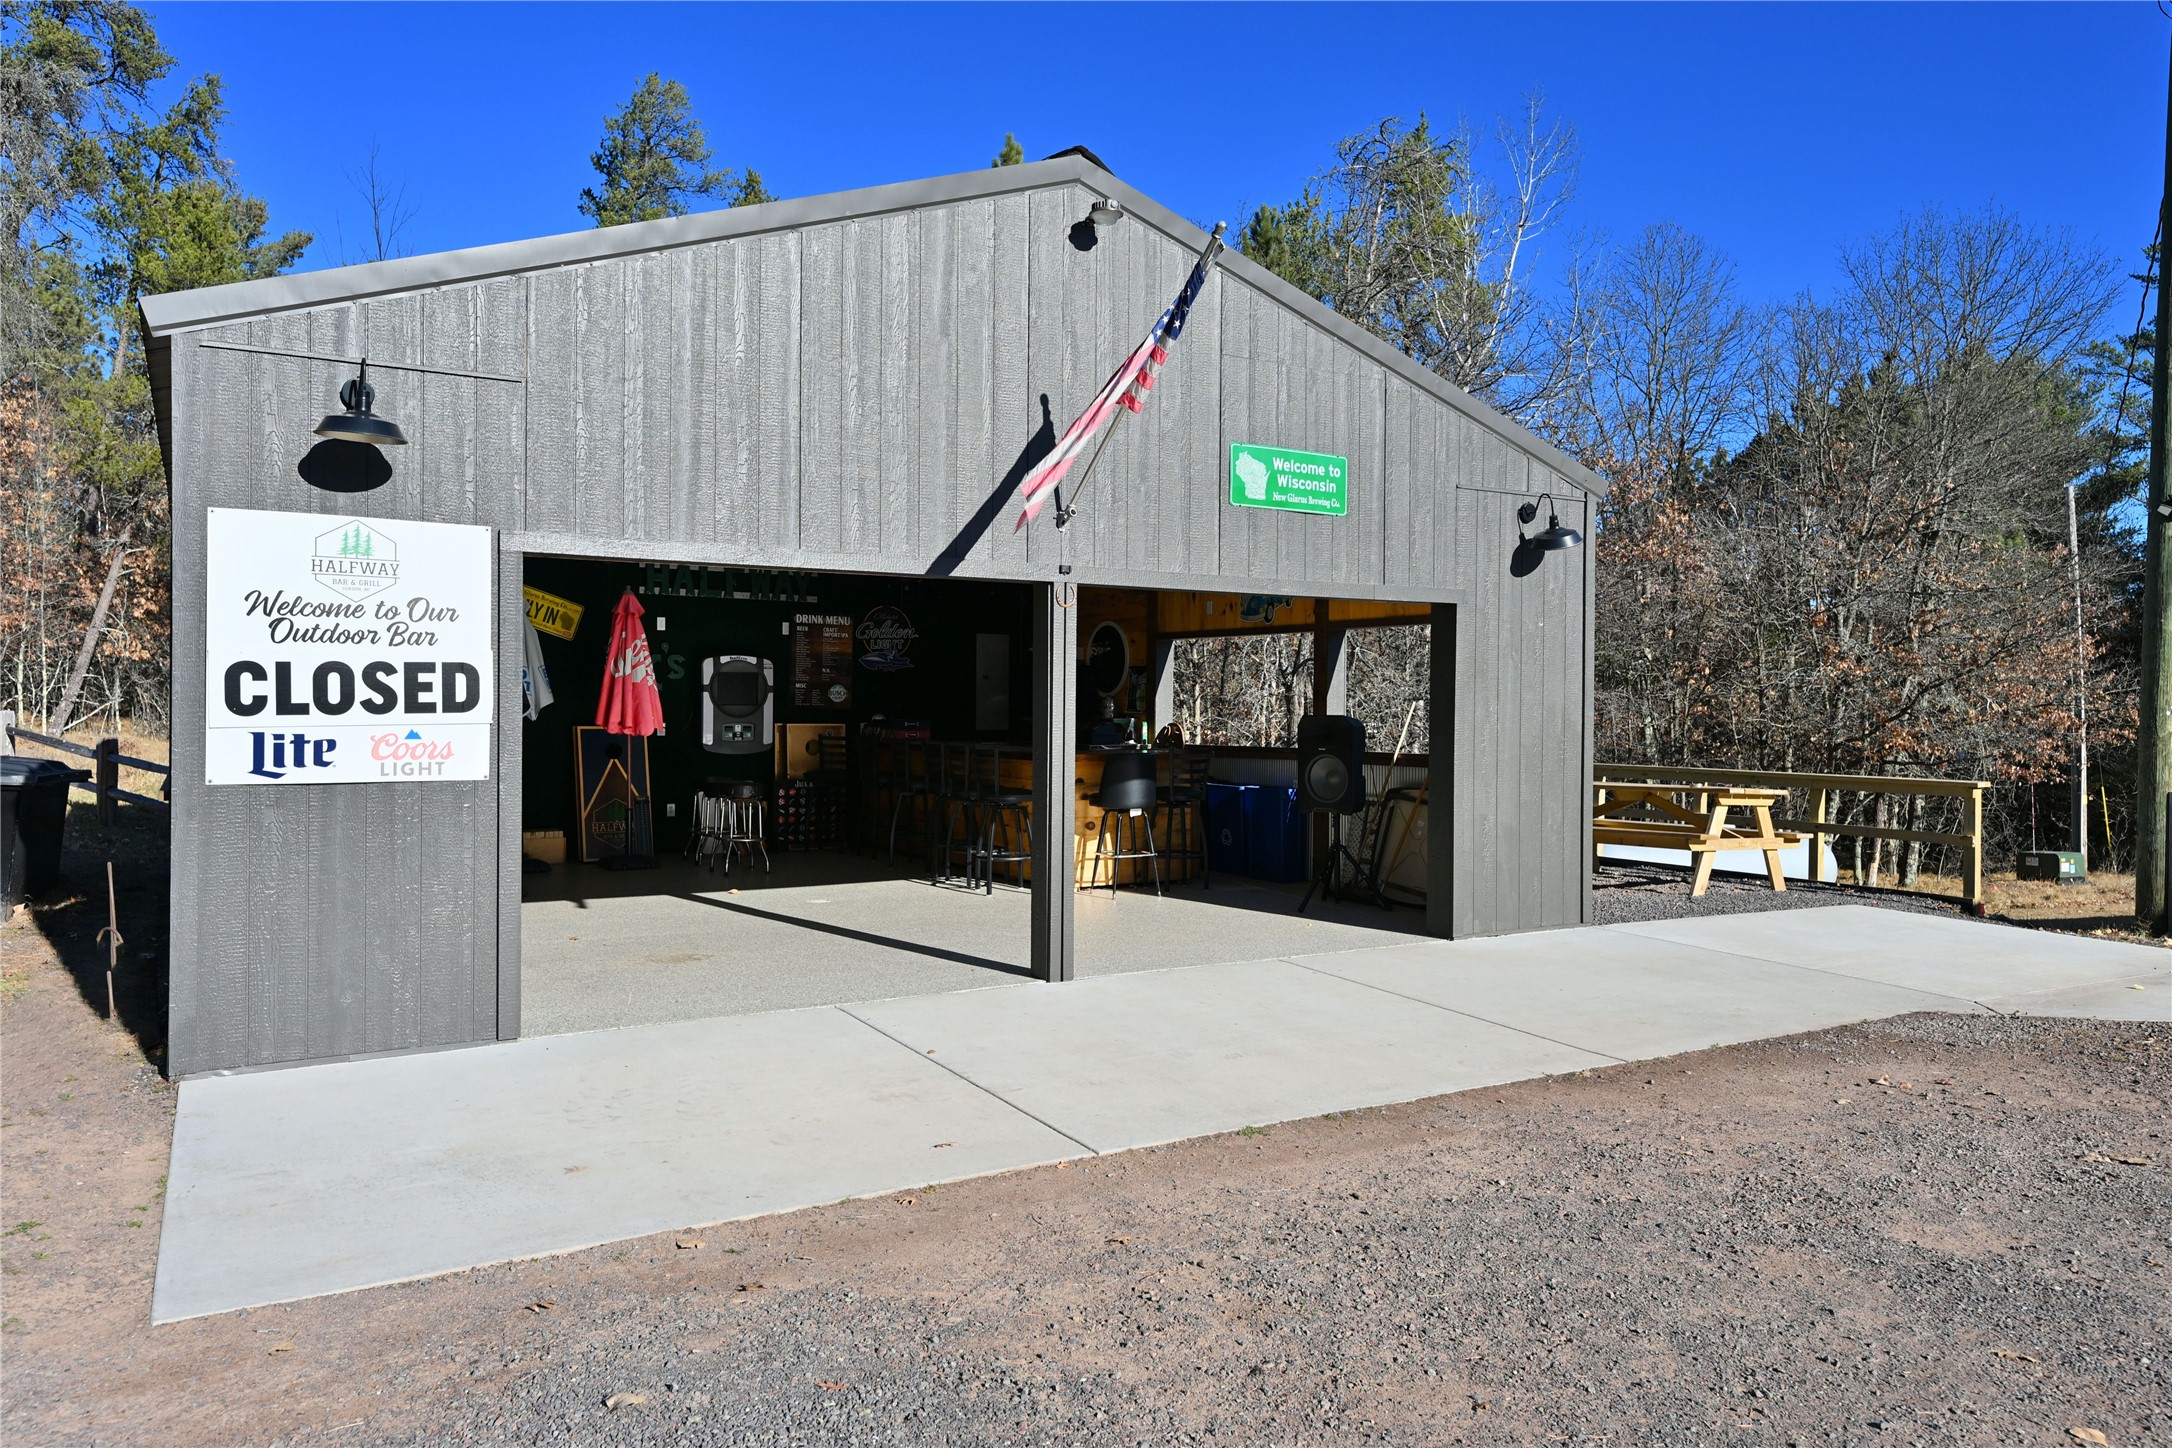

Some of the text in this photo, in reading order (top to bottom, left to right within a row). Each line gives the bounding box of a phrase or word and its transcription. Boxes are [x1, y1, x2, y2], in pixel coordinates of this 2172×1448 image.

[1272, 457, 1341, 478] Welcome to
[1277, 474, 1336, 493] Wisconsin
[1272, 492, 1287, 502] New
[1287, 493, 1308, 505] Glarus
[1308, 496, 1331, 509] Brewing
[311, 558, 400, 577] HALFWAY
[332, 578, 382, 588] BAR & GRILL
[645, 563, 811, 601] HALFWAY
[244, 590, 459, 622] Welcome to Our
[543, 606, 560, 626] IN
[795, 613, 851, 626] DRINK MENU
[268, 617, 438, 647] Outdoor Bar
[855, 620, 919, 639] Golden
[224, 660, 480, 717] CLOSED
[247, 731, 454, 779] Lite Coors
[380, 762, 445, 777] LIGHT
